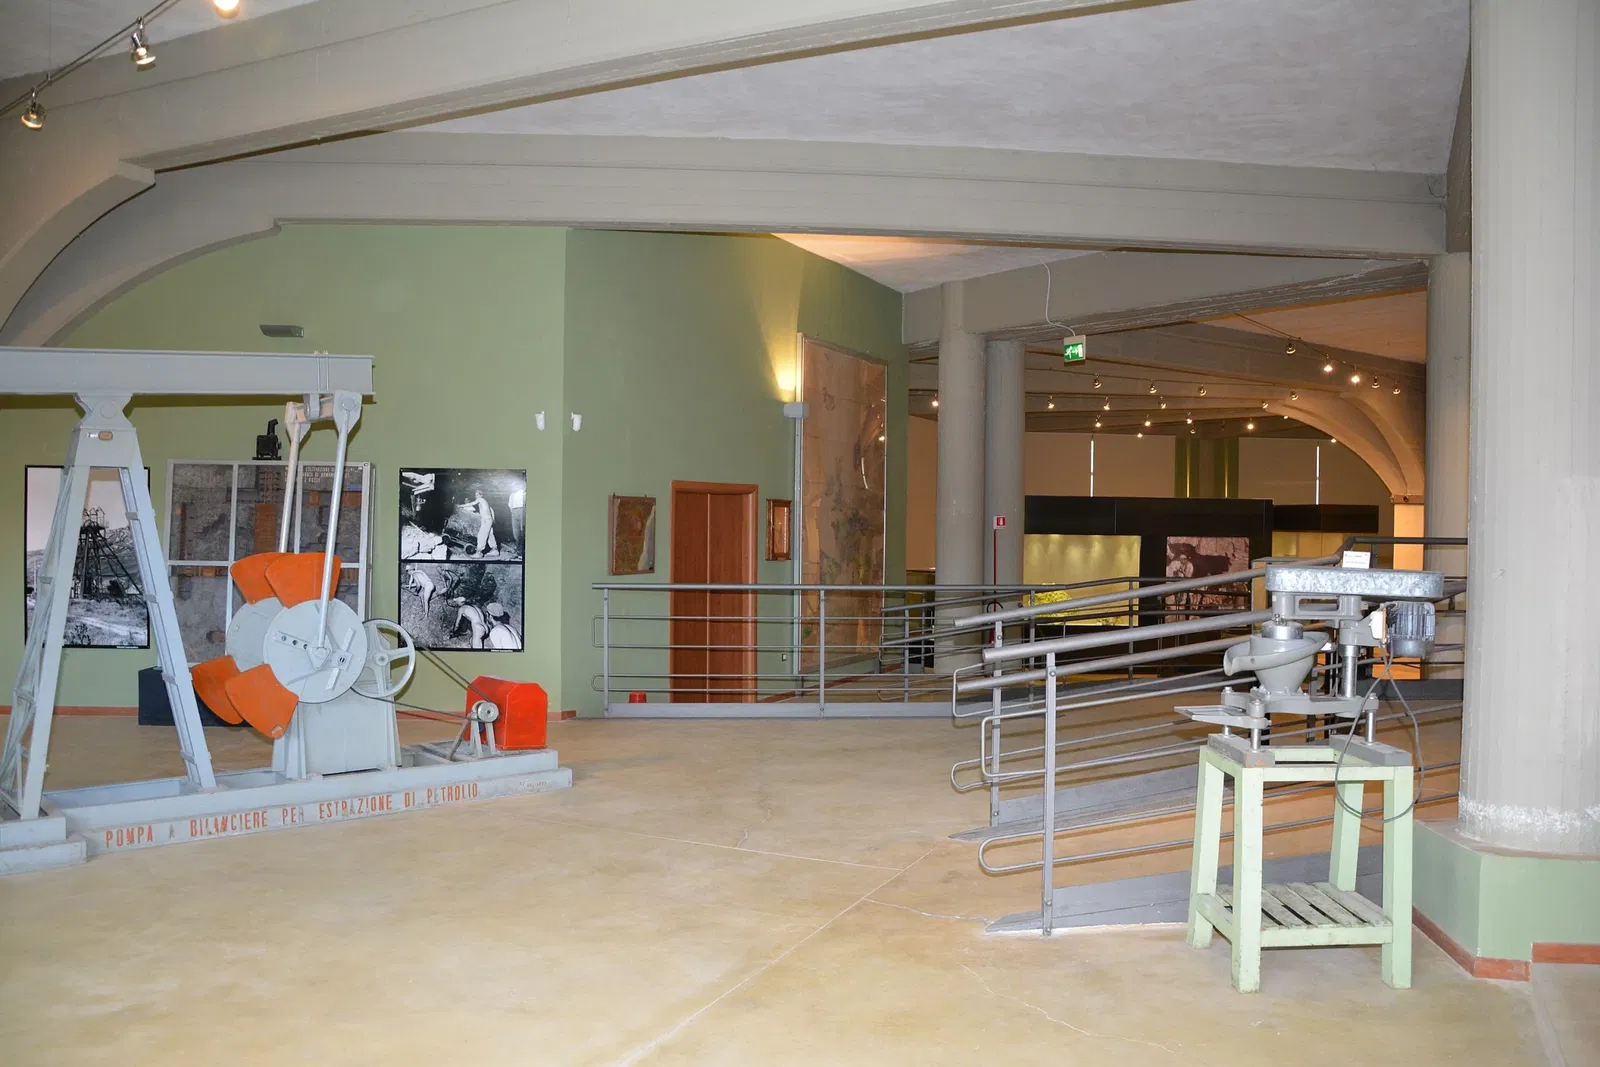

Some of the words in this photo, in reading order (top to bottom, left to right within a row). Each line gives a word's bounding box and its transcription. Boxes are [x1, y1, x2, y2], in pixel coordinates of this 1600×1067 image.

[105, 825, 154, 848] POMPA
[168, 823, 175, 839] A
[318, 793, 393, 820] ESTRAZIONE
[404, 791, 416, 808] DI
[427, 782, 479, 804] PETROLIO
